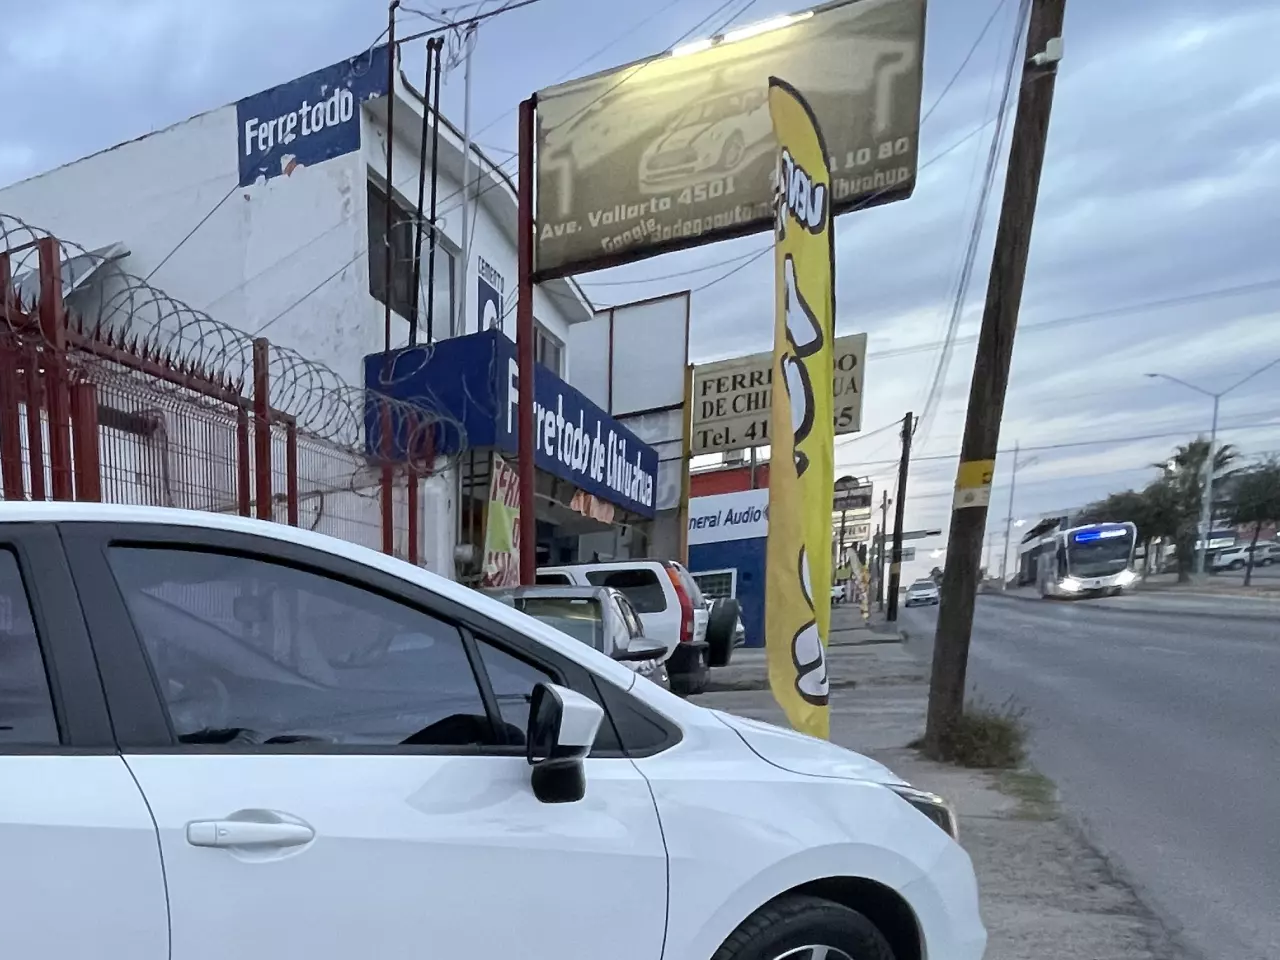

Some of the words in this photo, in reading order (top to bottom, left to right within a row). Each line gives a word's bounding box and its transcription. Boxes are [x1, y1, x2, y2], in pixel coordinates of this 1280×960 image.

[245, 86, 354, 156] Ferretodo
[540, 221, 582, 241] Ave.
[588, 196, 671, 229] Vallarta
[677, 177, 736, 204] 4501
[702, 397, 727, 420] DE
[590, 419, 606, 482] de
[697, 426, 737, 449] Tel.
[689, 510, 722, 530] neral
[723, 505, 762, 526] Audio
